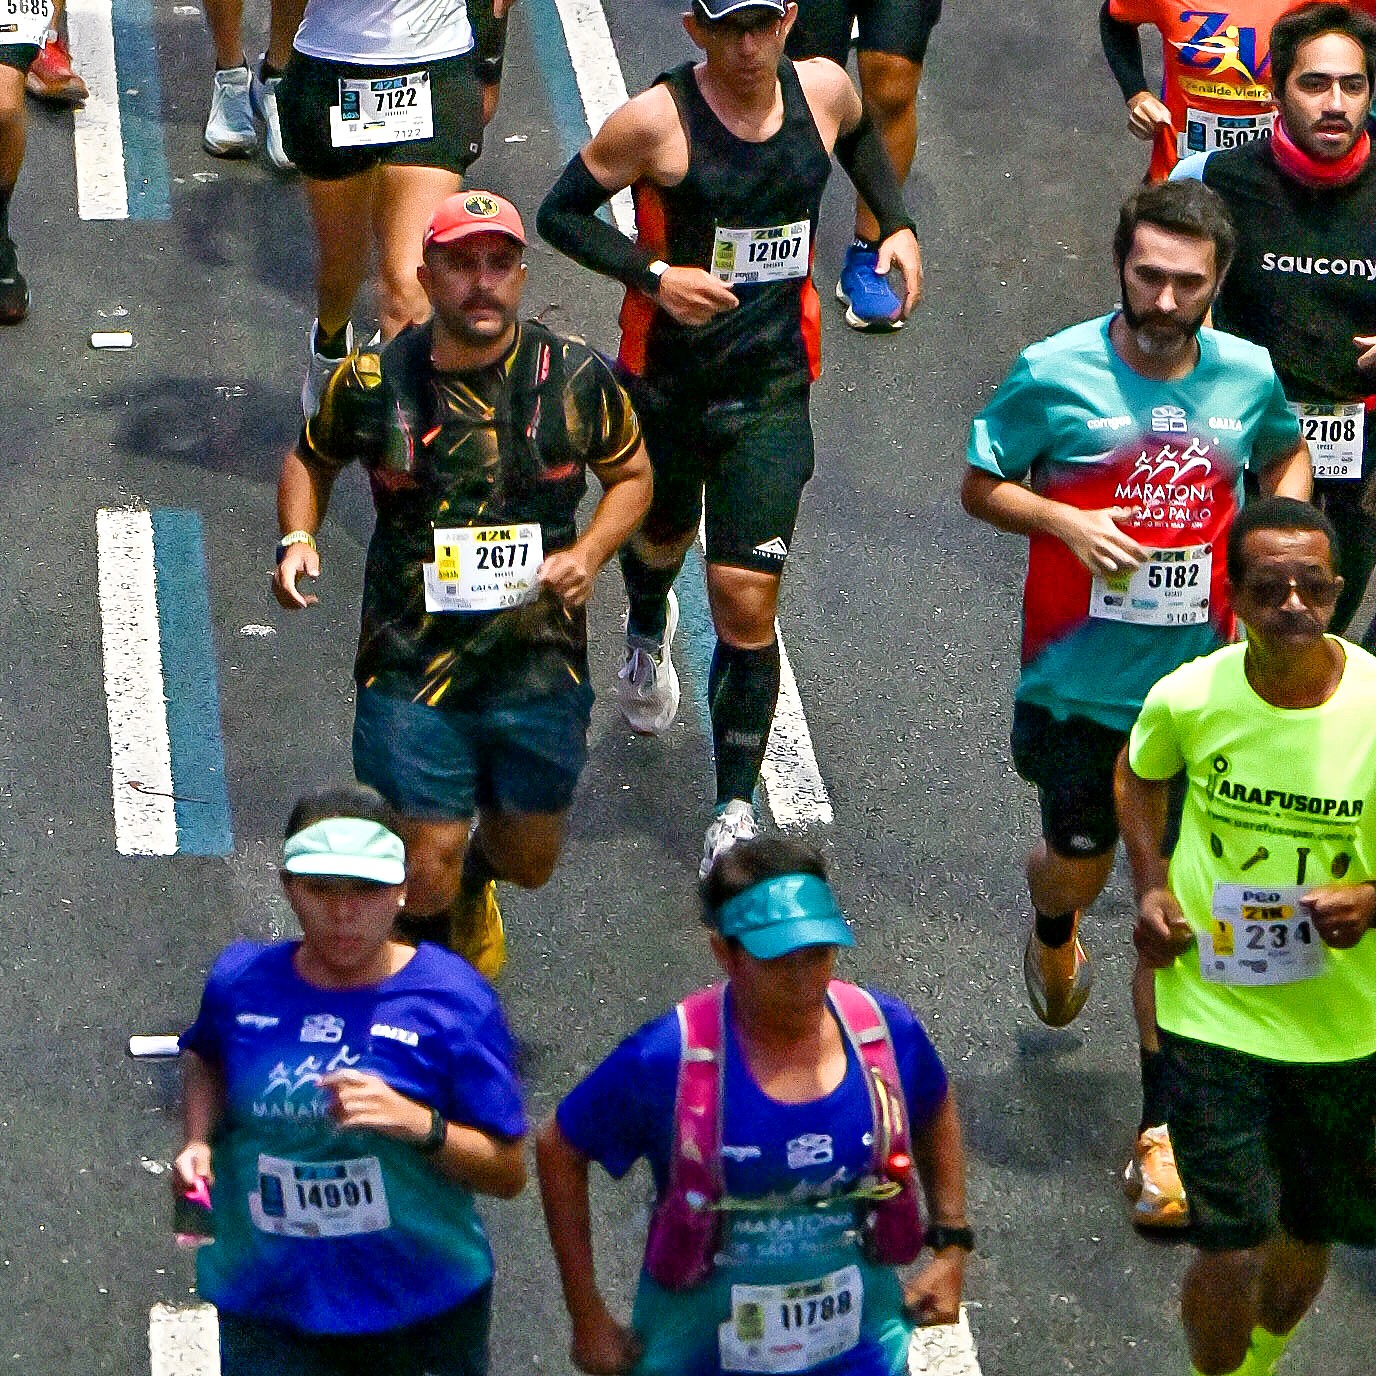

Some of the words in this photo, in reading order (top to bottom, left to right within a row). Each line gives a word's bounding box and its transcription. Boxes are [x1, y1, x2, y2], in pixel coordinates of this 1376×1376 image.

[374, 89, 417, 113] 7122
[393, 128, 422, 140] 7122
[747, 237, 799, 263] 12107
[1262, 252, 1376, 281] saucony
[1114, 482, 1213, 502] MARATONA
[475, 543, 528, 570] 2677
[1148, 563, 1199, 588] 5182
